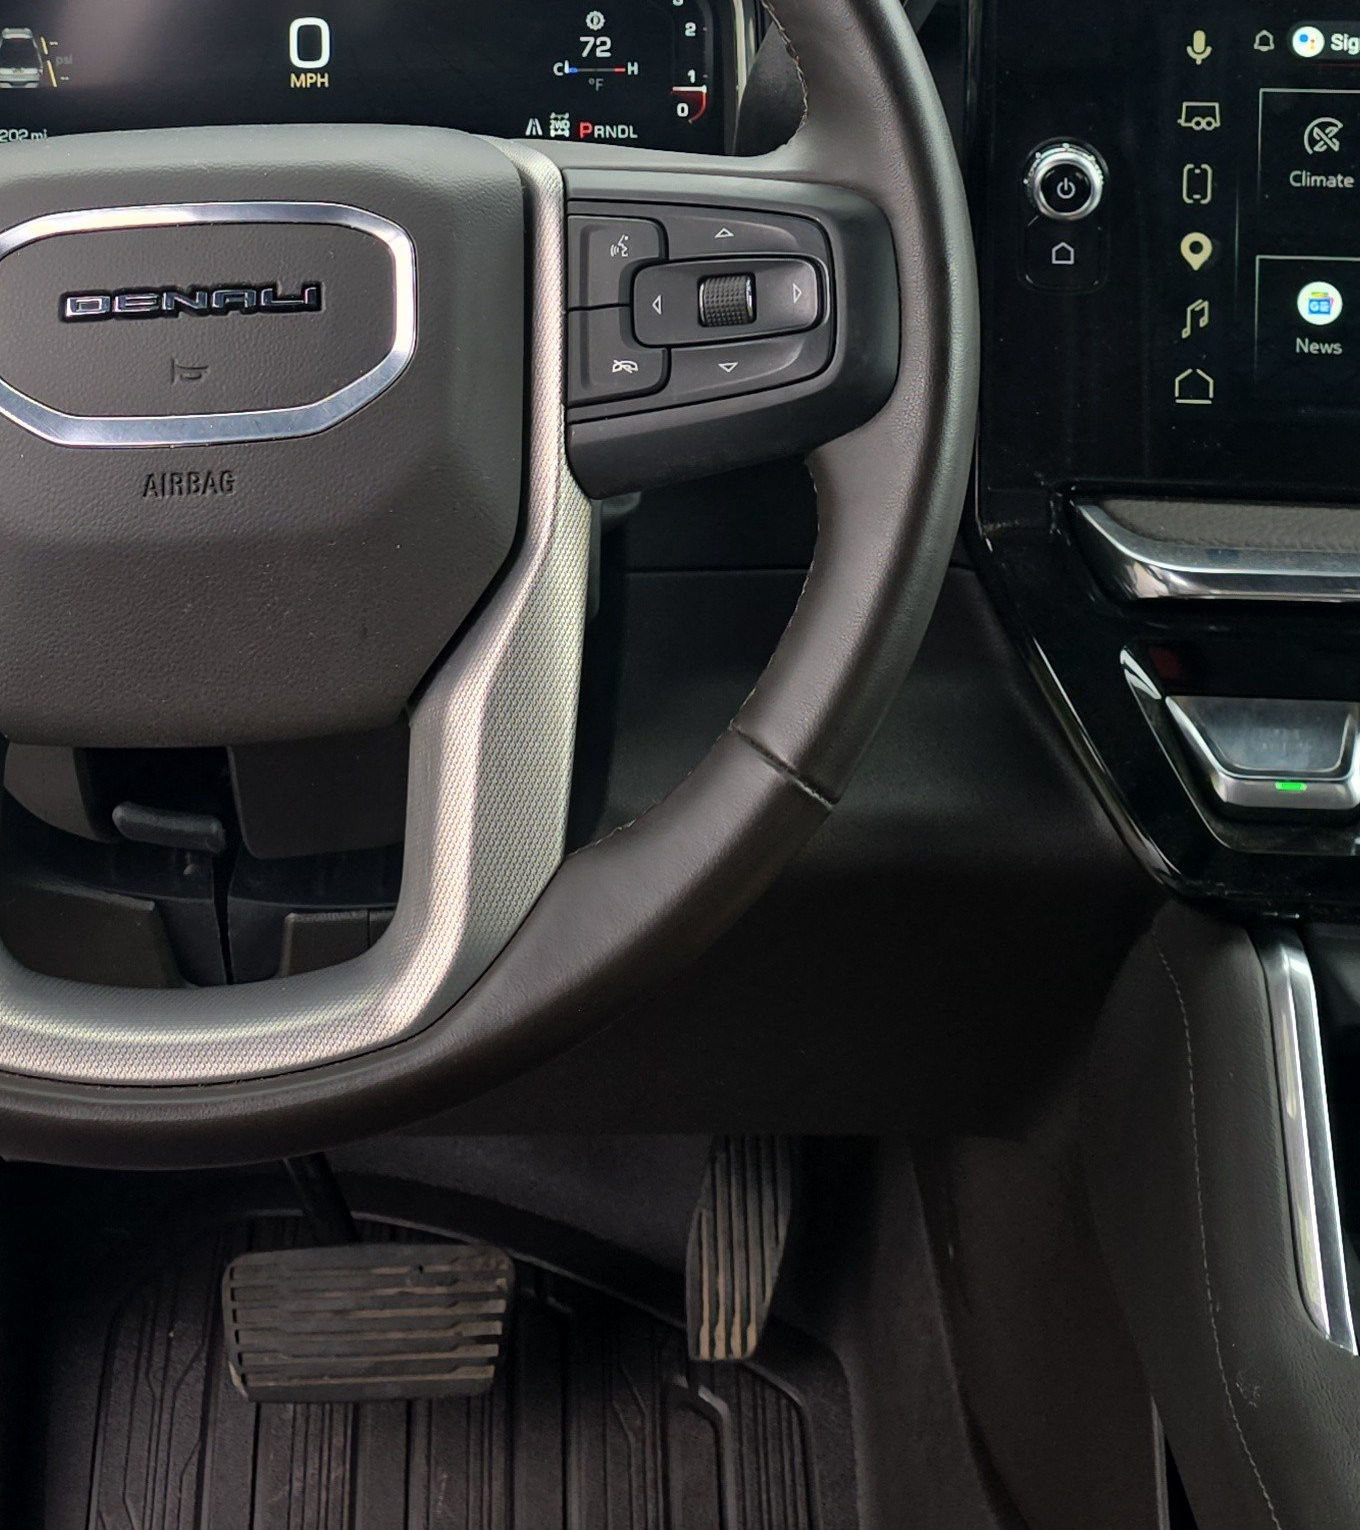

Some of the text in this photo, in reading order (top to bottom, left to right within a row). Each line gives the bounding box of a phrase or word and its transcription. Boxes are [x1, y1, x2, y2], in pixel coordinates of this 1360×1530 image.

[683, 21, 697, 37] 2
[289, 16, 331, 69] 0
[579, 35, 613, 58] 72
[289, 72, 329, 88] MPH
[687, 69, 697, 84] 1
[676, 102, 689, 117] 0
[1289, 171, 1355, 189] Climate
[64, 285, 321, 320] DENALI
[1295, 337, 1343, 355] News
[143, 471, 235, 497] AIRBAG
